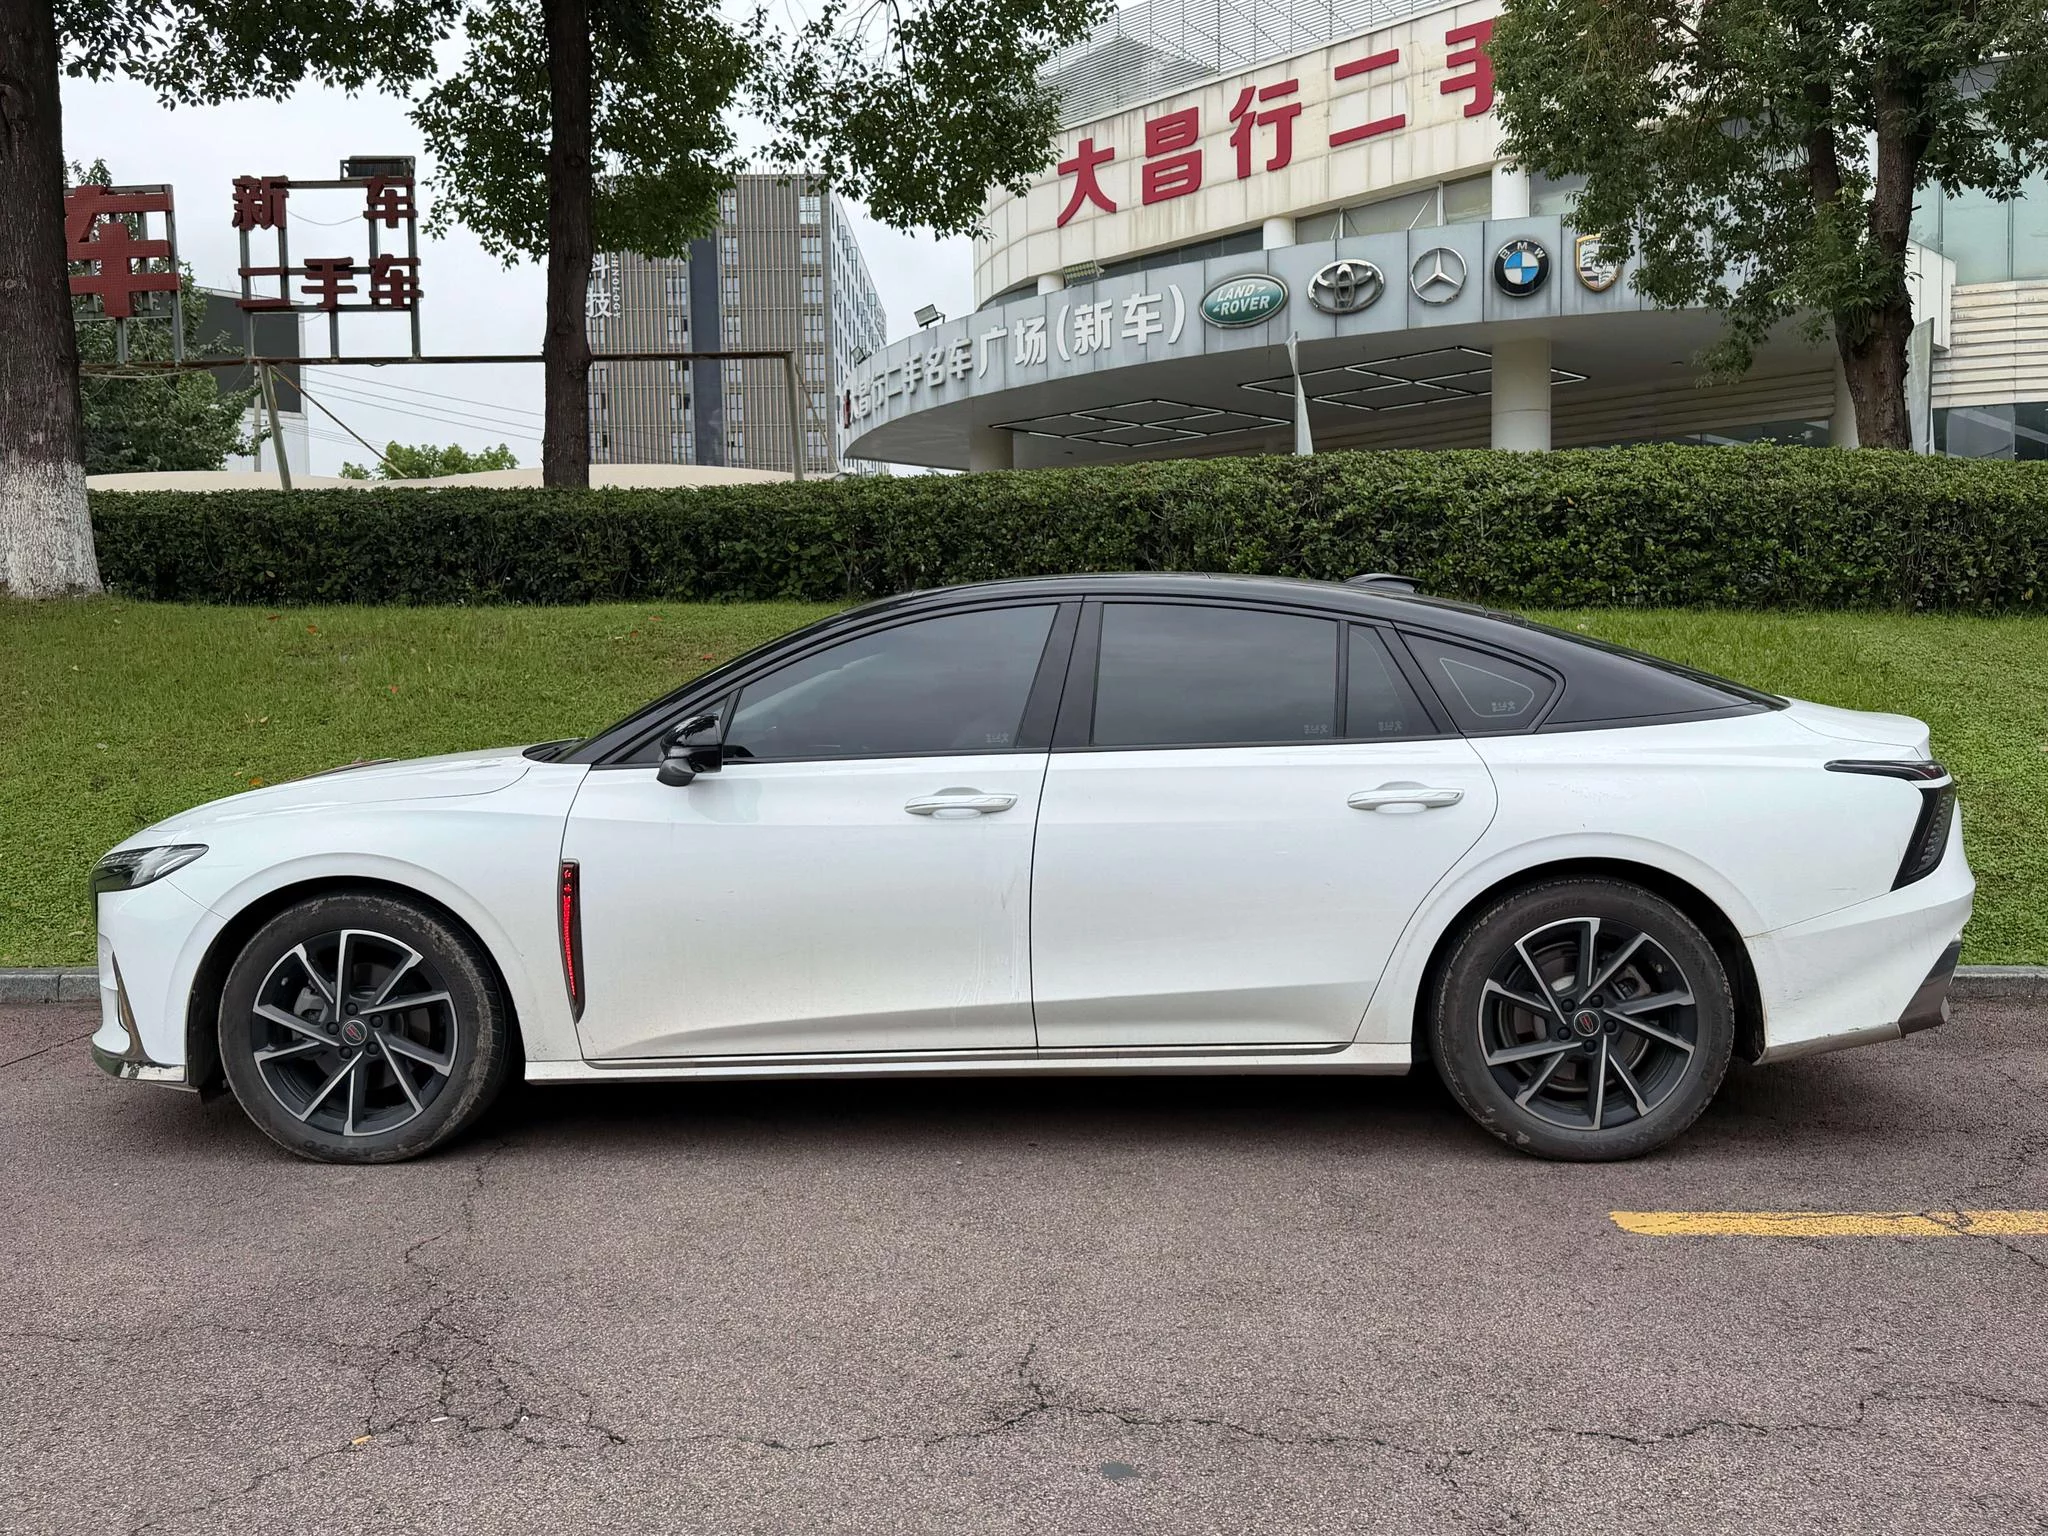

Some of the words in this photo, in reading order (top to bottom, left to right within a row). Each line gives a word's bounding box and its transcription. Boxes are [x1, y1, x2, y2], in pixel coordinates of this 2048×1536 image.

[1500, 241, 1546, 260] BMW
[235, 254, 424, 309] 二手车
[1217, 284, 1256, 302] LAND
[1220, 295, 1271, 316] ROVER
